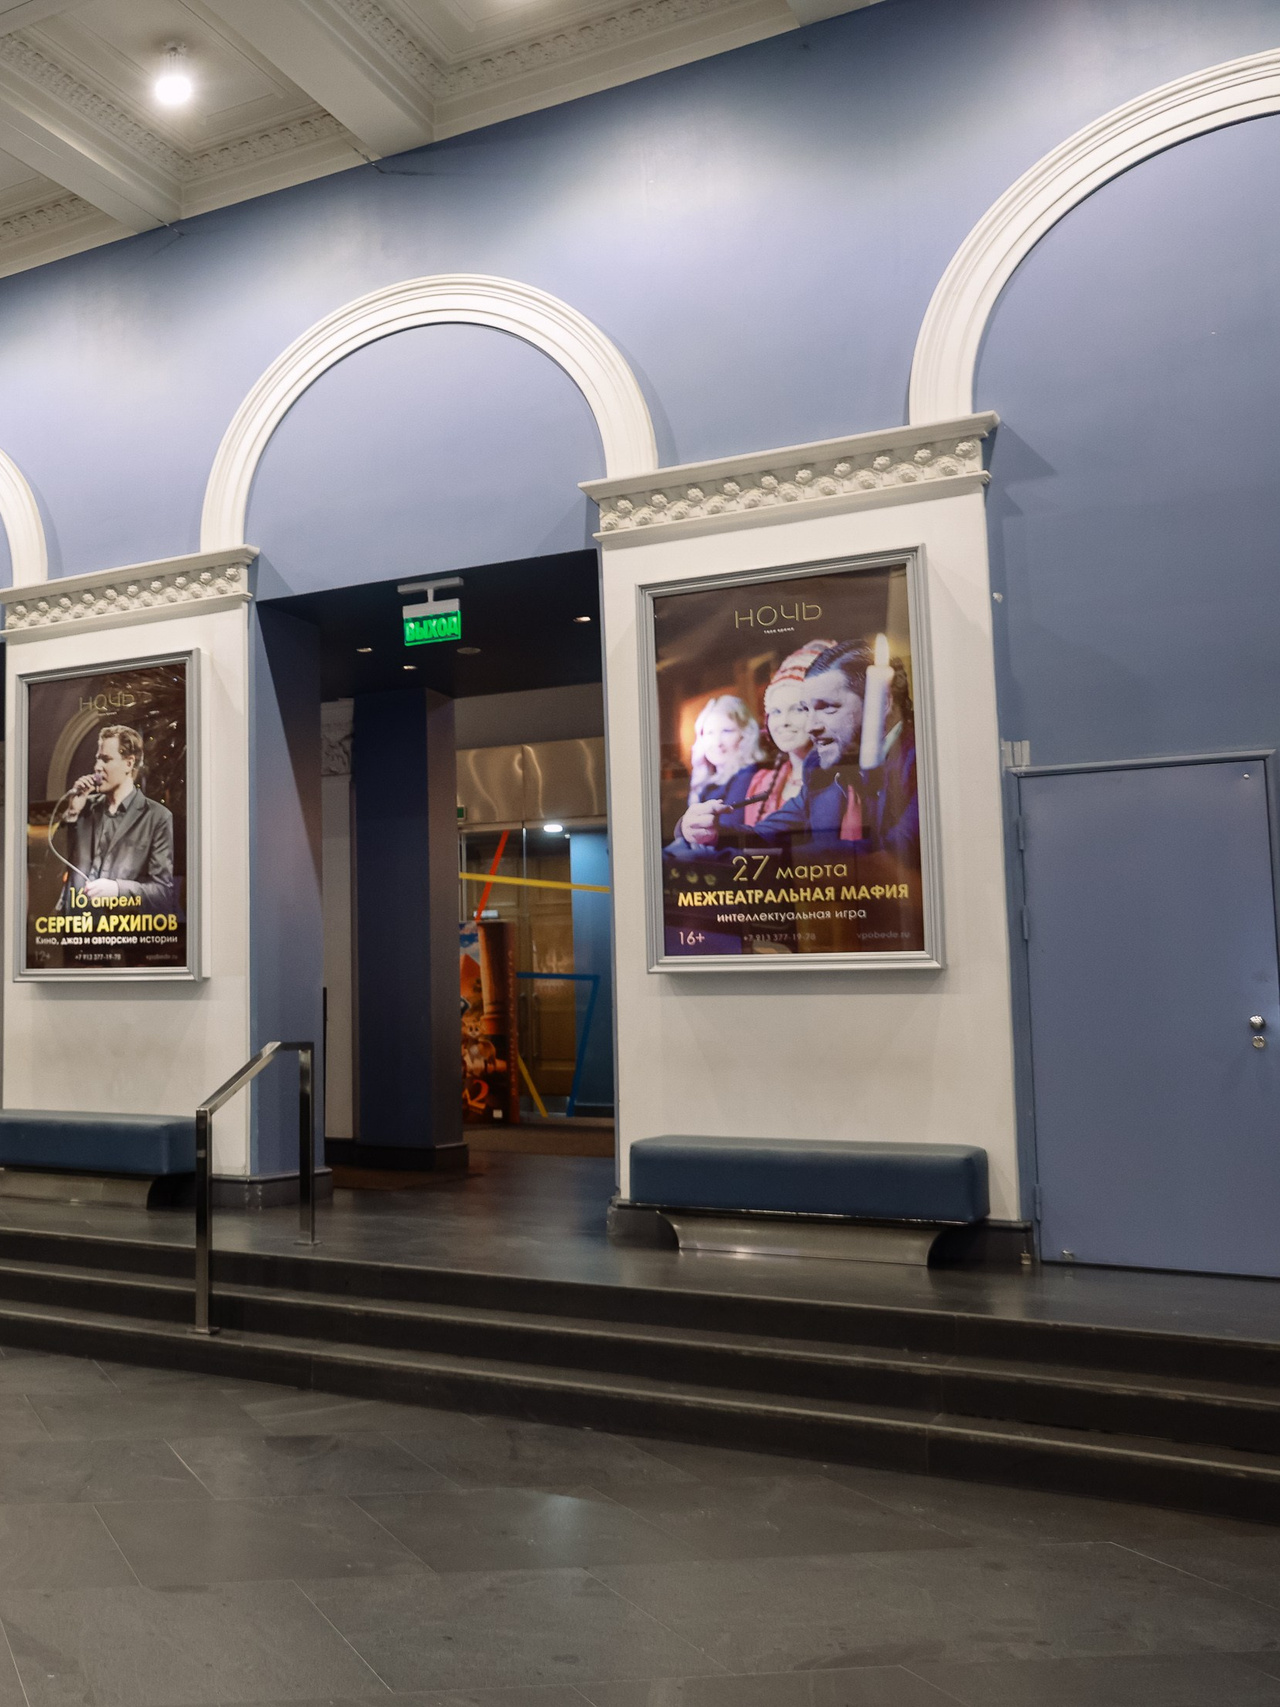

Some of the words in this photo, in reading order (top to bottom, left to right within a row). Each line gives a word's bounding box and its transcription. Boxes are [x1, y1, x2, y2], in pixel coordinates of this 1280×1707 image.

[735, 602, 822, 628] НОЧЬ
[406, 616, 459, 641] ВЫХОД
[732, 855, 770, 881] 27
[775, 862, 848, 881] марта
[70, 887, 88, 909] 16
[91, 895, 142, 910] апреля
[677, 886, 836, 907] МЕЖТЕАТРАЛЬНАЯ
[840, 883, 909, 901] МАФИЯ
[35, 912, 93, 933] СЕРГЕЙ
[96, 913, 178, 933] АРХИПОВ
[716, 910, 831, 923] интеллектуальная
[835, 908, 867, 921] игра
[35, 936, 60, 945] Кино,
[60, 936, 83, 945] джаз
[84, 936, 90, 945] и
[91, 935, 138, 946] авторские
[139, 935, 178, 945] истории
[678, 931, 705, 945] 16+
